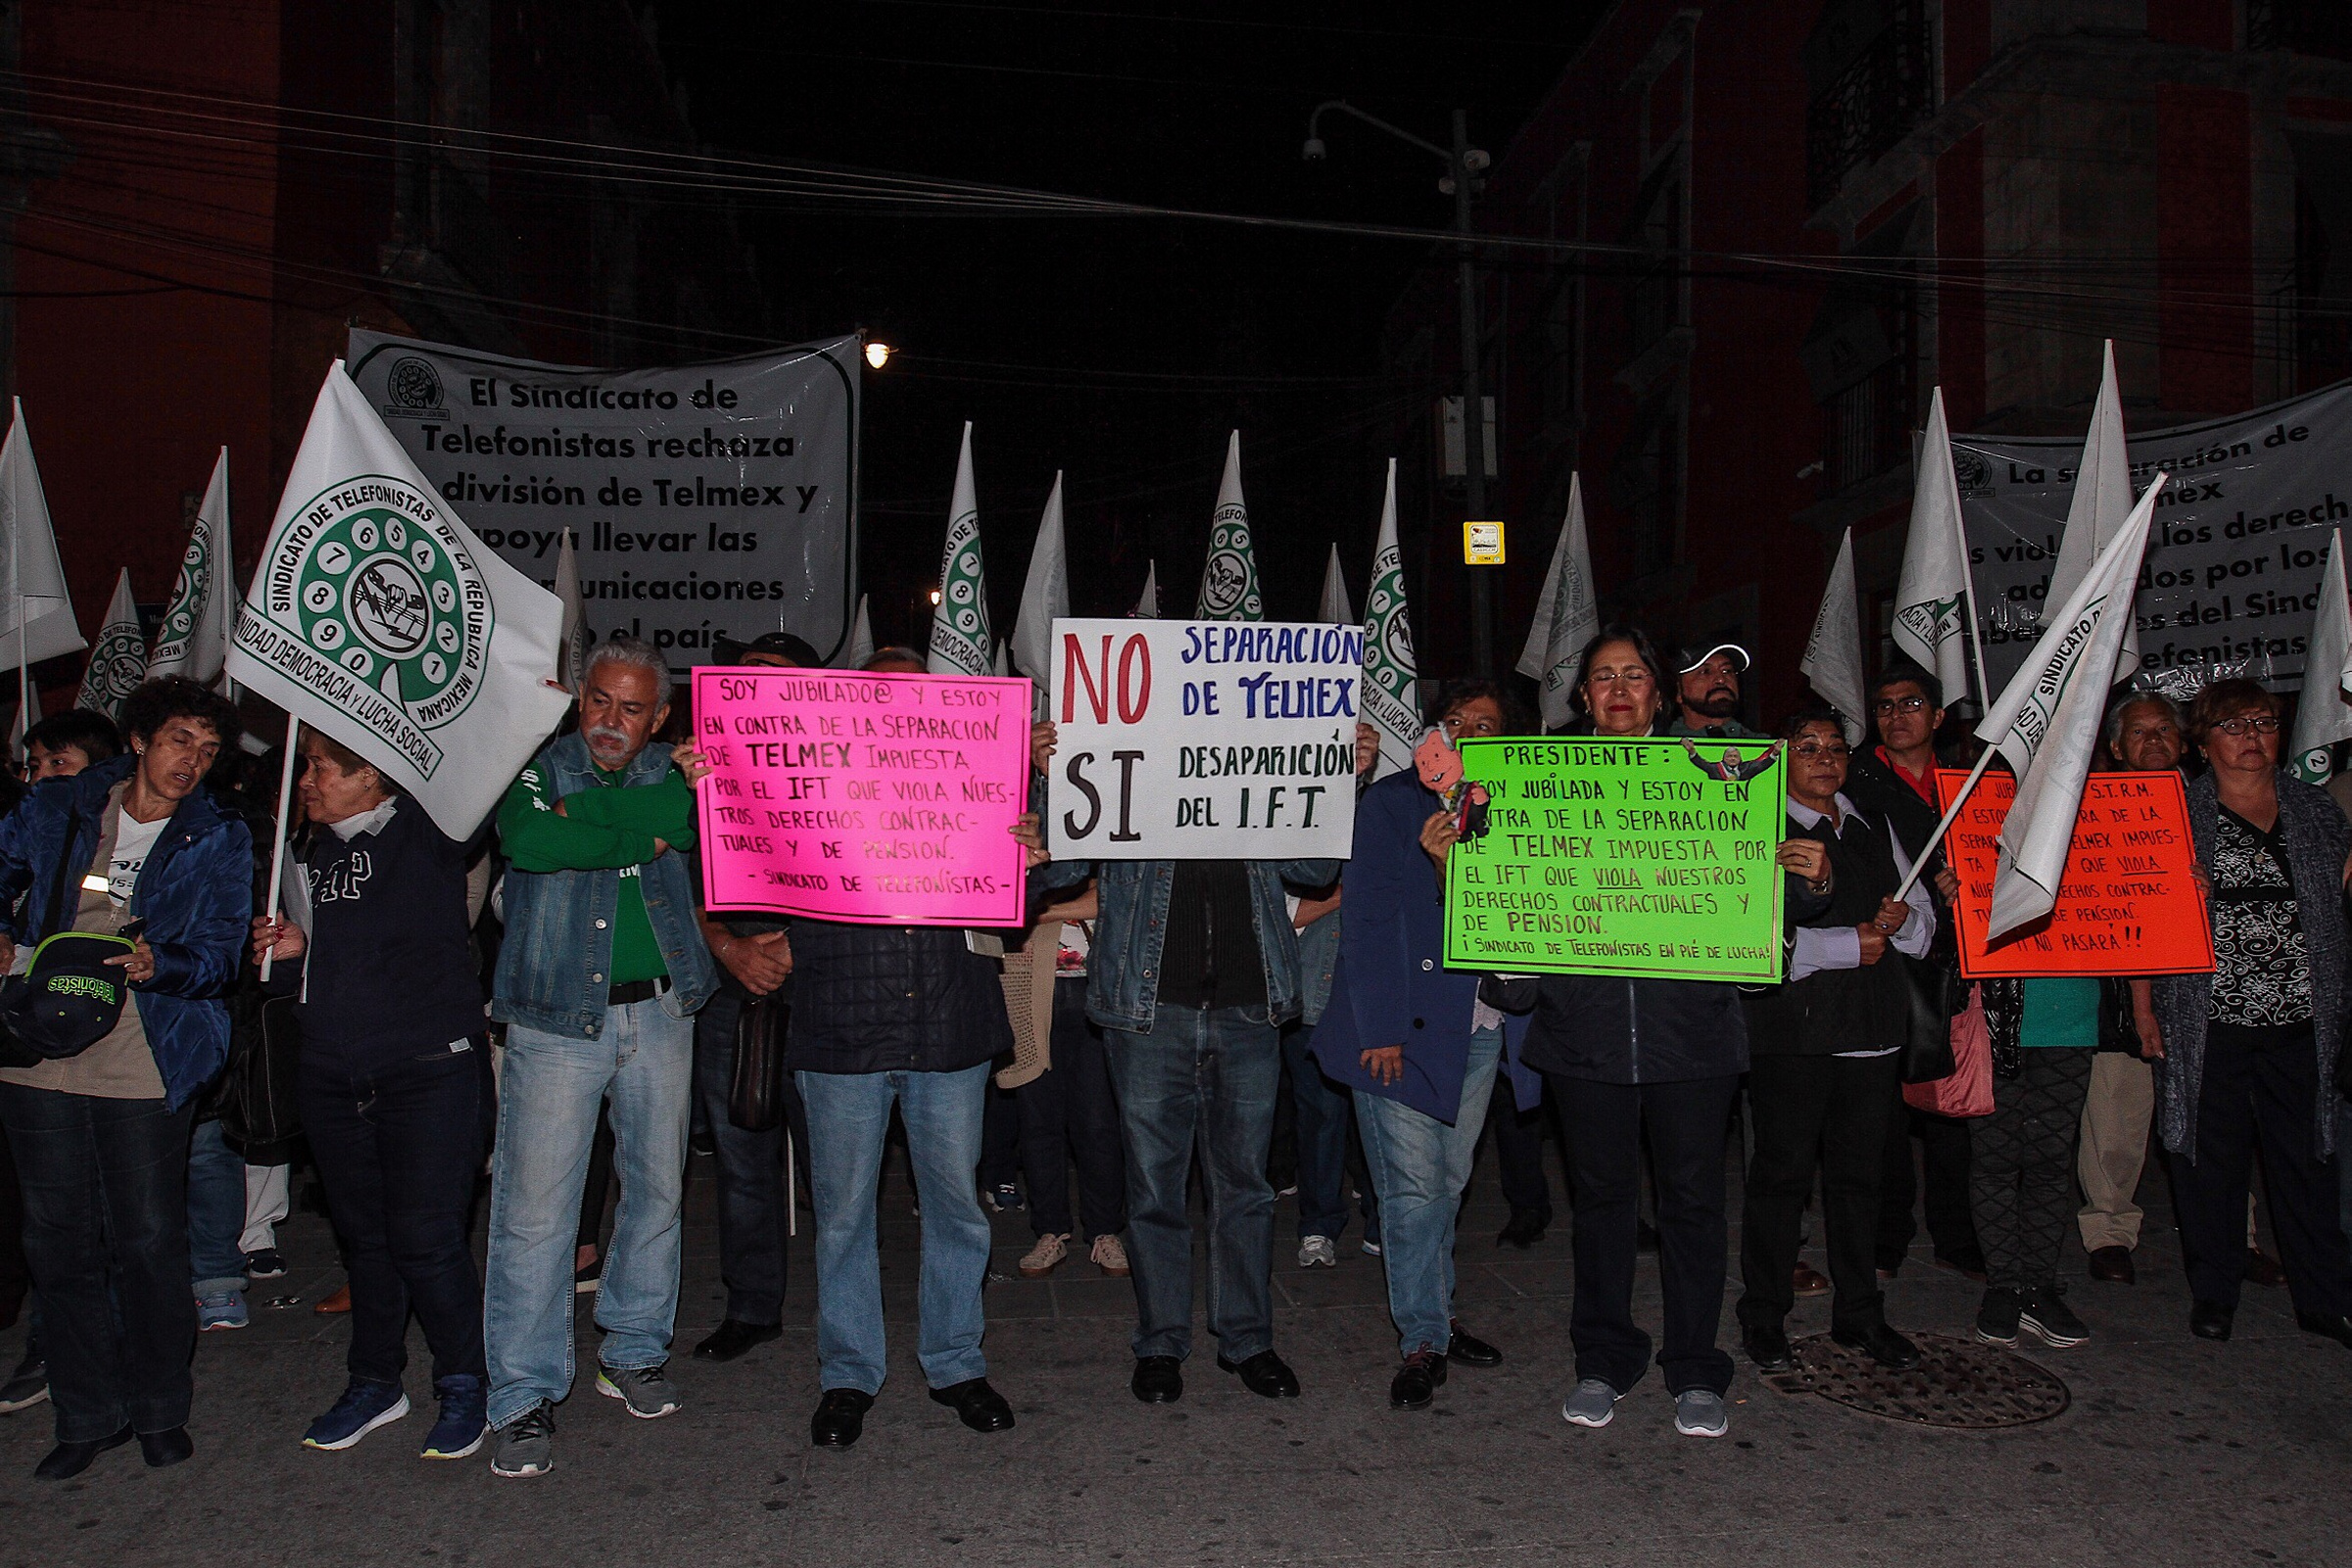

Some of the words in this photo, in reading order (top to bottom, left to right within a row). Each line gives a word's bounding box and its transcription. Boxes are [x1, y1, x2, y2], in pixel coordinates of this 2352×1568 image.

[471, 378, 498, 407] El
[510, 379, 678, 410] Sindicato
[691, 379, 738, 409] de
[421, 424, 635, 458] Telefonistas
[648, 427, 794, 457] rechaza
[2009, 463, 2045, 485] La
[2264, 423, 2310, 449] de
[330, 484, 435, 523] TELEFONISTAS
[443, 471, 585, 505] división
[598, 475, 642, 507] de
[653, 478, 786, 506] Telmex
[795, 485, 819, 514] y
[309, 502, 334, 527] DE
[2162, 522, 2213, 548] los
[2224, 493, 2350, 540] derech
[360, 525, 374, 545] 6
[391, 523, 401, 542] 5
[435, 525, 457, 546] DE
[593, 521, 696, 551] llevar
[707, 522, 757, 552] las
[953, 523, 971, 542] DE
[1235, 534, 1247, 545] 5
[326, 546, 346, 565] 7
[416, 548, 429, 565] 4
[454, 550, 473, 572] LA
[966, 556, 977, 568] 7
[272, 525, 313, 613] SINDICATO
[2207, 556, 2270, 590] por
[312, 587, 329, 606] 8
[438, 587, 450, 605] 3
[580, 571, 784, 600] unicaciones
[955, 585, 968, 598] 8
[1248, 599, 1260, 609] 2
[1375, 594, 1386, 606] 7
[2178, 595, 2232, 628] del
[464, 579, 484, 671] REPUBLICA
[962, 613, 974, 627] 9
[1367, 623, 1374, 637] 8
[319, 624, 338, 642] 9
[442, 627, 454, 647] 2
[1181, 624, 1364, 665] SEPARACIÓN
[350, 652, 366, 672] 0
[1367, 649, 1377, 664] 9
[2040, 619, 2091, 696] SINDICATO
[2141, 637, 2307, 670] efonistas
[430, 660, 442, 676] 1
[1061, 632, 1152, 725] NO
[1380, 671, 1392, 685] 0
[416, 672, 474, 724] MEXICANA
[720, 679, 757, 701] SOY
[780, 682, 893, 704] JUBILADO@
[911, 687, 924, 704] Y
[941, 689, 1001, 707] ESTOY
[1182, 681, 1220, 716] DE
[1238, 672, 1357, 719] TELMEX
[270, 640, 355, 705] DEMOCRACIA
[357, 694, 402, 738] LUCHA
[396, 725, 434, 773] SOCIAL
[1381, 700, 1414, 736] LUCHA
[704, 715, 724, 735] EN
[736, 716, 807, 736] CONTRA
[820, 716, 844, 736] DE
[853, 718, 878, 737] LA
[883, 715, 1000, 741] SEPARACION
[705, 745, 732, 767] DE
[745, 742, 852, 769] TELMEX
[865, 745, 970, 770] IMPUESTA
[1178, 728, 1355, 779] DESAPARICIÓN
[715, 777, 742, 798] POR
[752, 781, 774, 800] EL
[788, 777, 832, 801] IFT
[847, 781, 882, 801] QUE
[892, 780, 949, 802] VIOLA
[962, 776, 1016, 804] NUES-
[1064, 750, 1144, 842] SI
[1618, 781, 1629, 799] Y
[1643, 781, 1704, 802] ESTOY
[1725, 780, 1751, 802] EN
[2090, 783, 2153, 799] S.T.R.M.
[714, 807, 756, 827] TROS
[766, 810, 865, 832] DERECHOS
[880, 806, 979, 832] CONTRAC-
[1176, 797, 1220, 828] DEL
[1547, 809, 1571, 830] DE
[1583, 809, 1606, 831] LA
[1618, 809, 1750, 832] SEPARACION
[2109, 809, 2131, 823] DE
[2139, 806, 2162, 821] LA
[716, 834, 774, 856] TUALES
[785, 839, 798, 858] Y
[821, 841, 842, 859] DE
[1507, 834, 1595, 859] TELMEX
[1608, 840, 1719, 861] IMPUESTA
[1735, 840, 1767, 861] POR
[2072, 832, 2113, 850] ELMEX
[2123, 829, 2181, 847] IMPUES-
[1464, 866, 1485, 884] EL
[1495, 865, 1531, 885] IFT
[1544, 867, 1578, 886] QUE
[1594, 868, 1642, 887] VIOLA
[1656, 866, 1747, 886] NUESTROS
[1964, 858, 1985, 873] TA
[2080, 857, 2109, 874] QUE
[2117, 855, 2162, 872] VIOLA
[763, 869, 829, 891] SINDICATO
[840, 876, 862, 893] DE
[2107, 882, 2171, 898] CONTRAC-
[1464, 891, 1559, 910] DERECHOS
[1572, 893, 1718, 916] CONTRACTUALES
[1737, 893, 1750, 915] Y
[1464, 915, 1488, 931] DE
[1508, 913, 1608, 934] PENSION.
[1474, 936, 1535, 955] SINDICATO
[1545, 941, 1562, 956] DE
[1565, 938, 1653, 959] TELEFONISTAS
[1659, 942, 1674, 958] EN
[1680, 938, 1700, 958] PIÉ
[1704, 944, 1721, 959] DE
[1727, 943, 1771, 961] LUCHA!
[2035, 933, 2052, 952] NO
